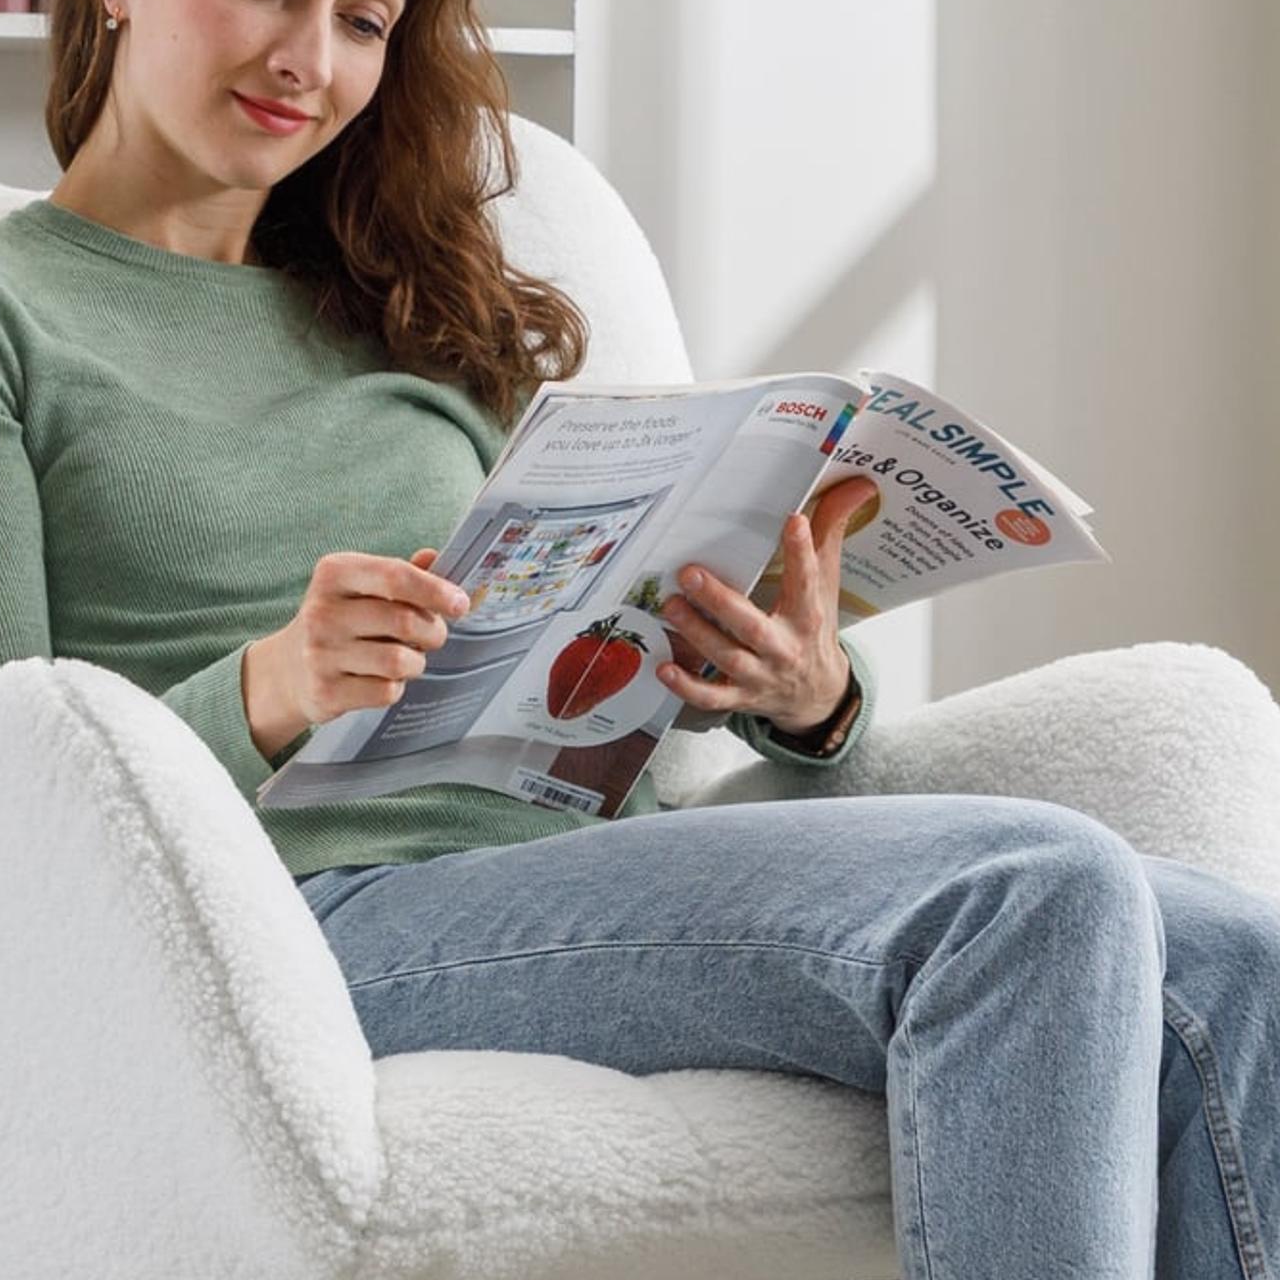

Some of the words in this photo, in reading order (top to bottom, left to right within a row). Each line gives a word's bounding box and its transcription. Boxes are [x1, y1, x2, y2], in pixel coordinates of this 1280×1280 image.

[776, 402, 828, 421] BOSCH
[872, 457, 898, 476] &
[895, 468, 1004, 551] Organize
[930, 423, 1056, 520] SIMPLE
